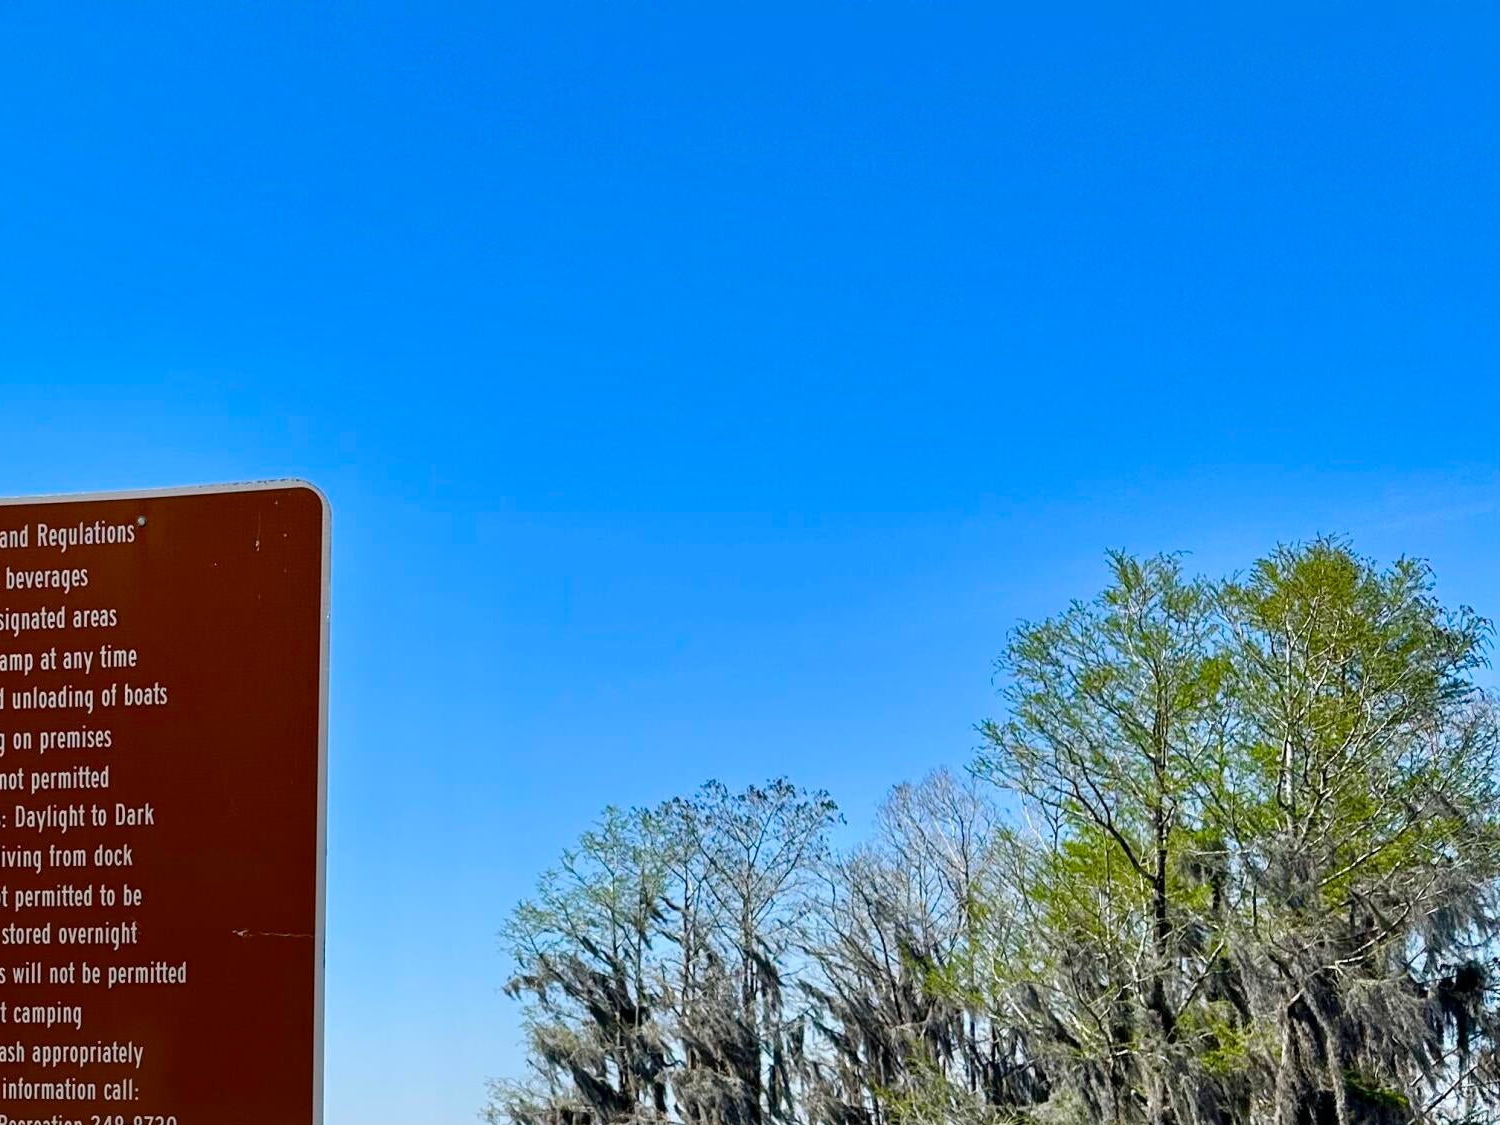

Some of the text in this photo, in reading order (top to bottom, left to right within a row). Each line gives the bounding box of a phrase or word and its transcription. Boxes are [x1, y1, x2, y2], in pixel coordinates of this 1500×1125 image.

[0, 525, 28, 548] and
[38, 521, 134, 551] Regulations
[6, 567, 88, 594] beverages
[73, 609, 116, 627] areas
[41, 648, 56, 670] at
[63, 652, 93, 674] any
[100, 645, 136, 667] time
[13, 685, 93, 714] unloading
[102, 684, 116, 706] of
[125, 682, 167, 705] boats
[14, 733, 31, 749] on
[41, 725, 111, 754] premises
[0, 768, 24, 790] not
[32, 766, 108, 794] permitted
[16, 805, 85, 833] Daylight
[91, 805, 106, 826] to
[116, 803, 154, 825] Dark
[50, 845, 86, 866] from
[95, 844, 132, 866] dock
[16, 885, 92, 912] permitted
[100, 885, 115, 906] to
[124, 884, 141, 905] be
[2, 923, 50, 944] stored
[59, 922, 137, 950] overnight
[13, 962, 41, 983] will
[50, 962, 74, 983] not
[83, 962, 100, 983] be
[109, 961, 186, 988] permitted
[14, 1002, 81, 1030] camping
[33, 1041, 143, 1068] appropriately
[3, 1078, 95, 1099] information
[104, 1079, 138, 1100] call:
